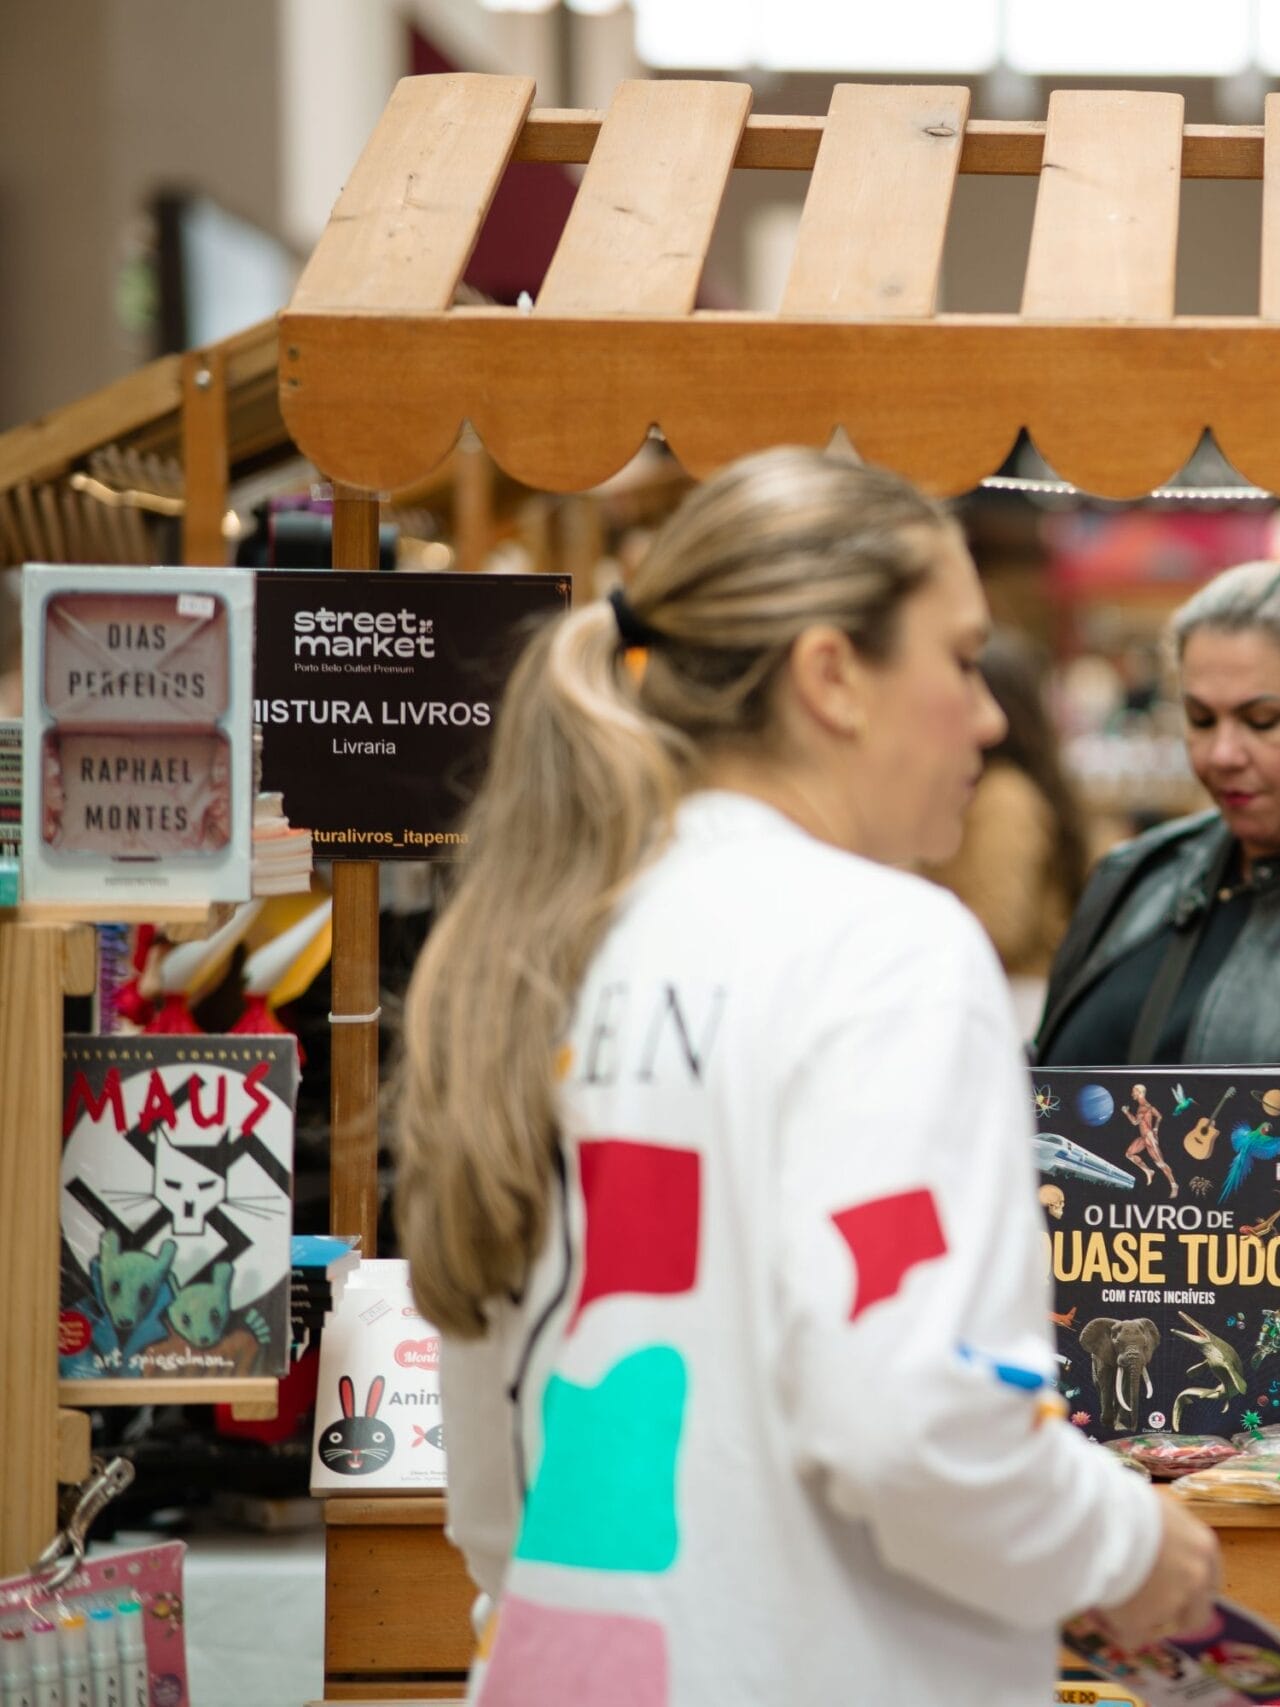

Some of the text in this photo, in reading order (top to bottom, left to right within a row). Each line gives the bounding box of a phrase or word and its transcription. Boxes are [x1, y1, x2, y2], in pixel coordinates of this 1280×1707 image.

[294, 607, 417, 633] street
[108, 623, 166, 650] DIAS
[294, 632, 435, 658] market
[294, 662, 415, 674] Porto Belo Outlet Premium
[68, 670, 205, 698] PERFEITOS
[382, 701, 491, 726] LIVROS
[332, 738, 397, 755] Livraria
[81, 757, 192, 783] RAPHAEL
[85, 804, 188, 831] MONTES
[63, 1061, 272, 1138] MAUS
[1084, 1204, 1234, 1230] O LIVRO DE
[1102, 1287, 1216, 1304] COM FATOS INCRÍVEIS
[93, 1347, 122, 1370] art
